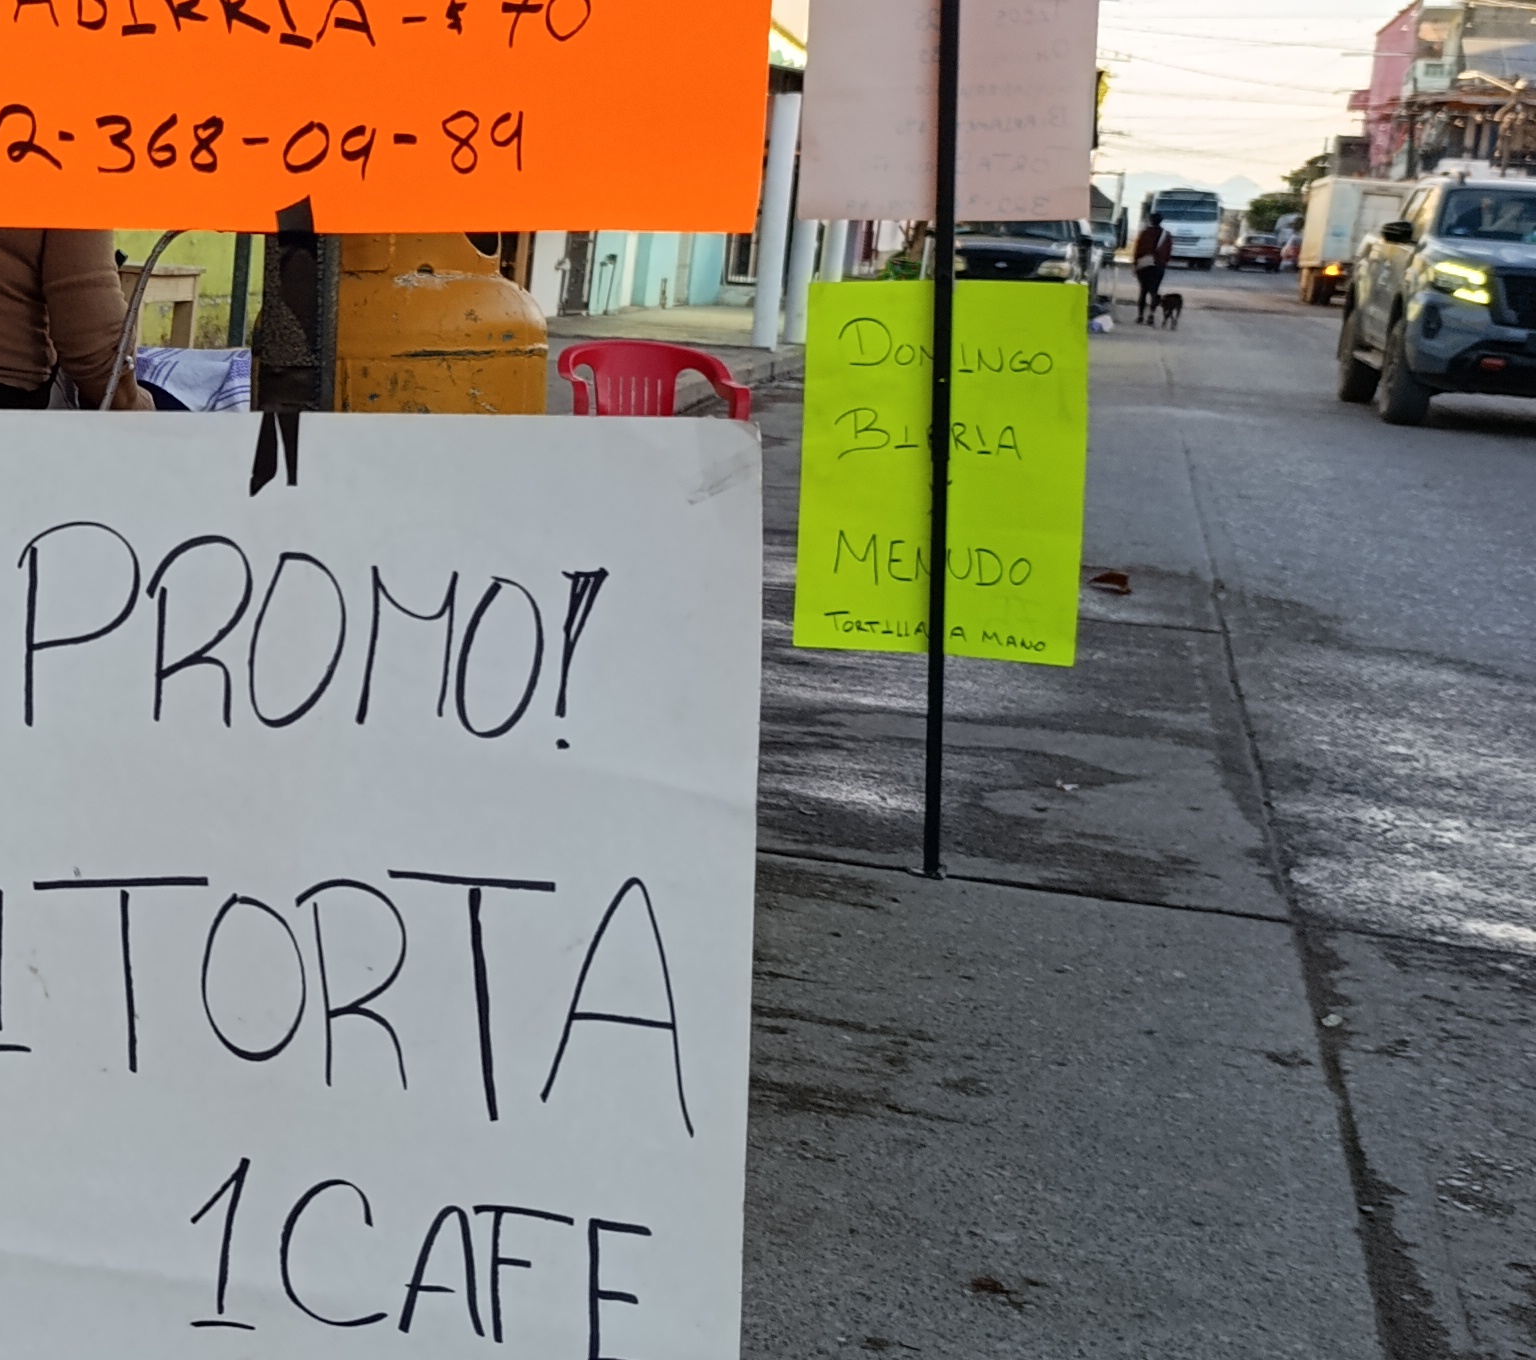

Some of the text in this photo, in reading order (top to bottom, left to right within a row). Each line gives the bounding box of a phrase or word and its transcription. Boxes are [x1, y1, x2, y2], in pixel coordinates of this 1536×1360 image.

[834, 407, 1022, 460] BIRIA
[950, 625, 967, 642] A
[981, 628, 1047, 652] MANO
